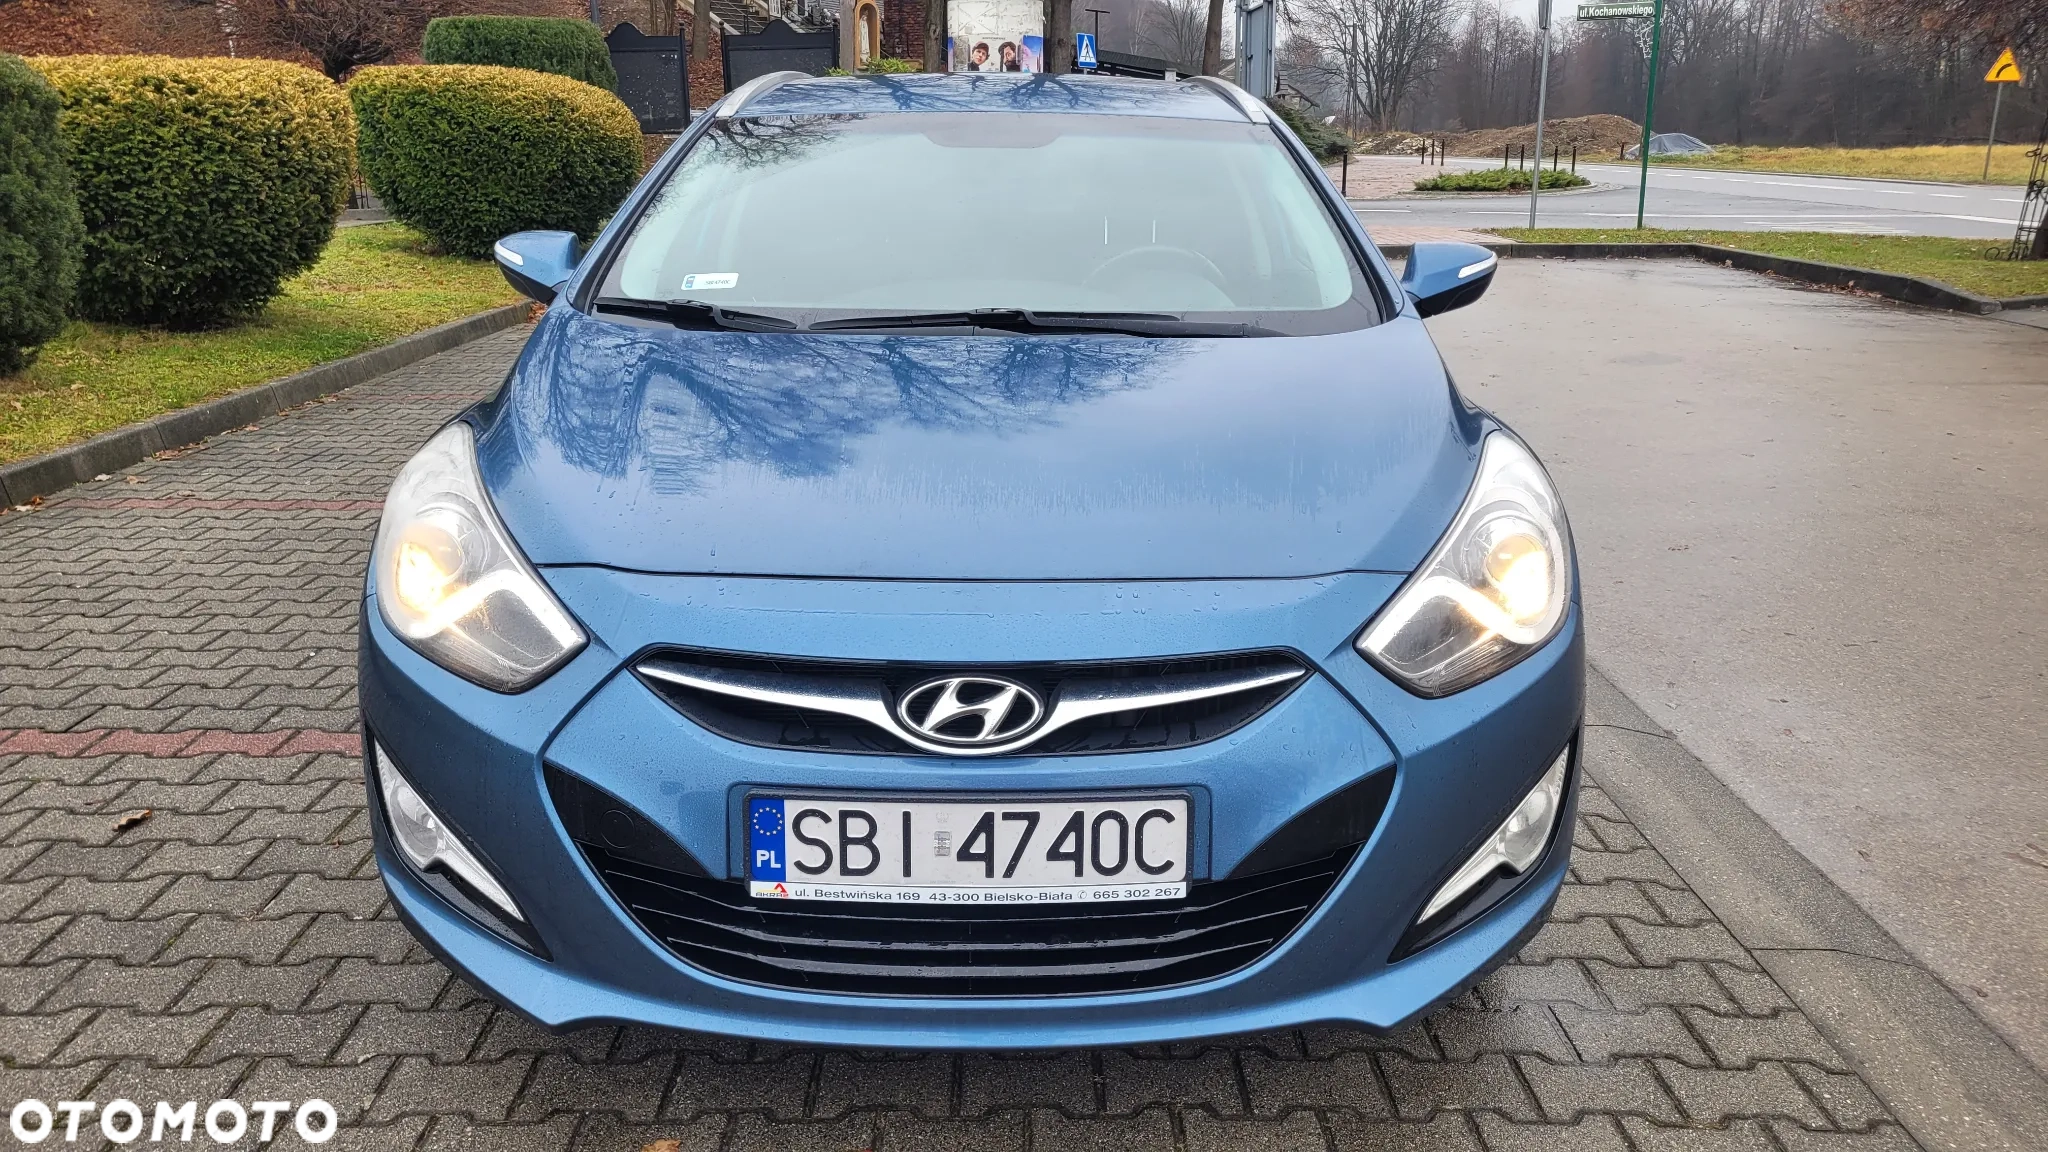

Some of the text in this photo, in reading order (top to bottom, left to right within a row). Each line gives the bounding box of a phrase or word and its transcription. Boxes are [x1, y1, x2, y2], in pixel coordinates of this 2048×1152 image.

[792, 808, 1176, 879] SBI 4740C
[757, 850, 781, 868] PL
[795, 888, 1181, 901] ul. Bestwińska 169 43-300 Bielsko-Biała 665 302 267
